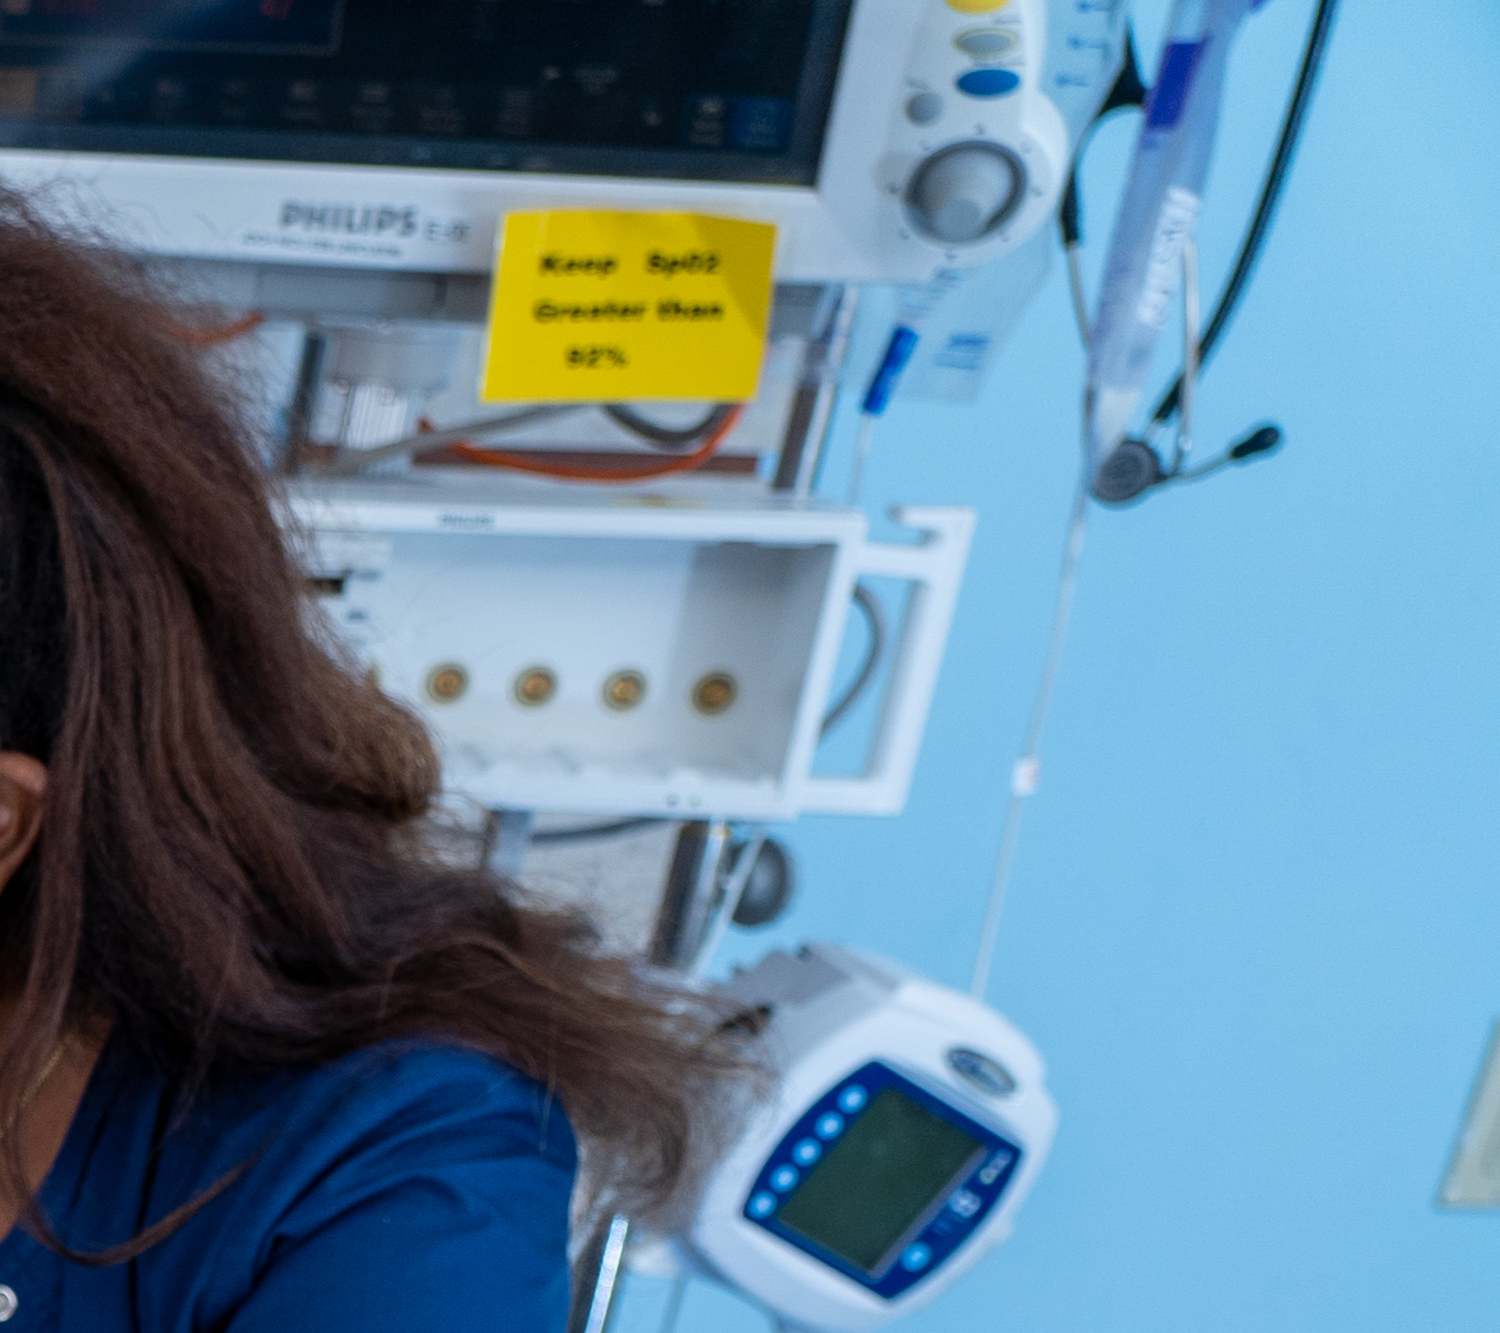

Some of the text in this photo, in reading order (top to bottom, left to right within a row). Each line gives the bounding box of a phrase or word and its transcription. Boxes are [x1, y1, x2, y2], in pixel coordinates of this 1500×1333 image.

[280, 198, 417, 238] PHILIPS
[539, 253, 618, 277] Keep
[533, 300, 725, 324] Greater than
